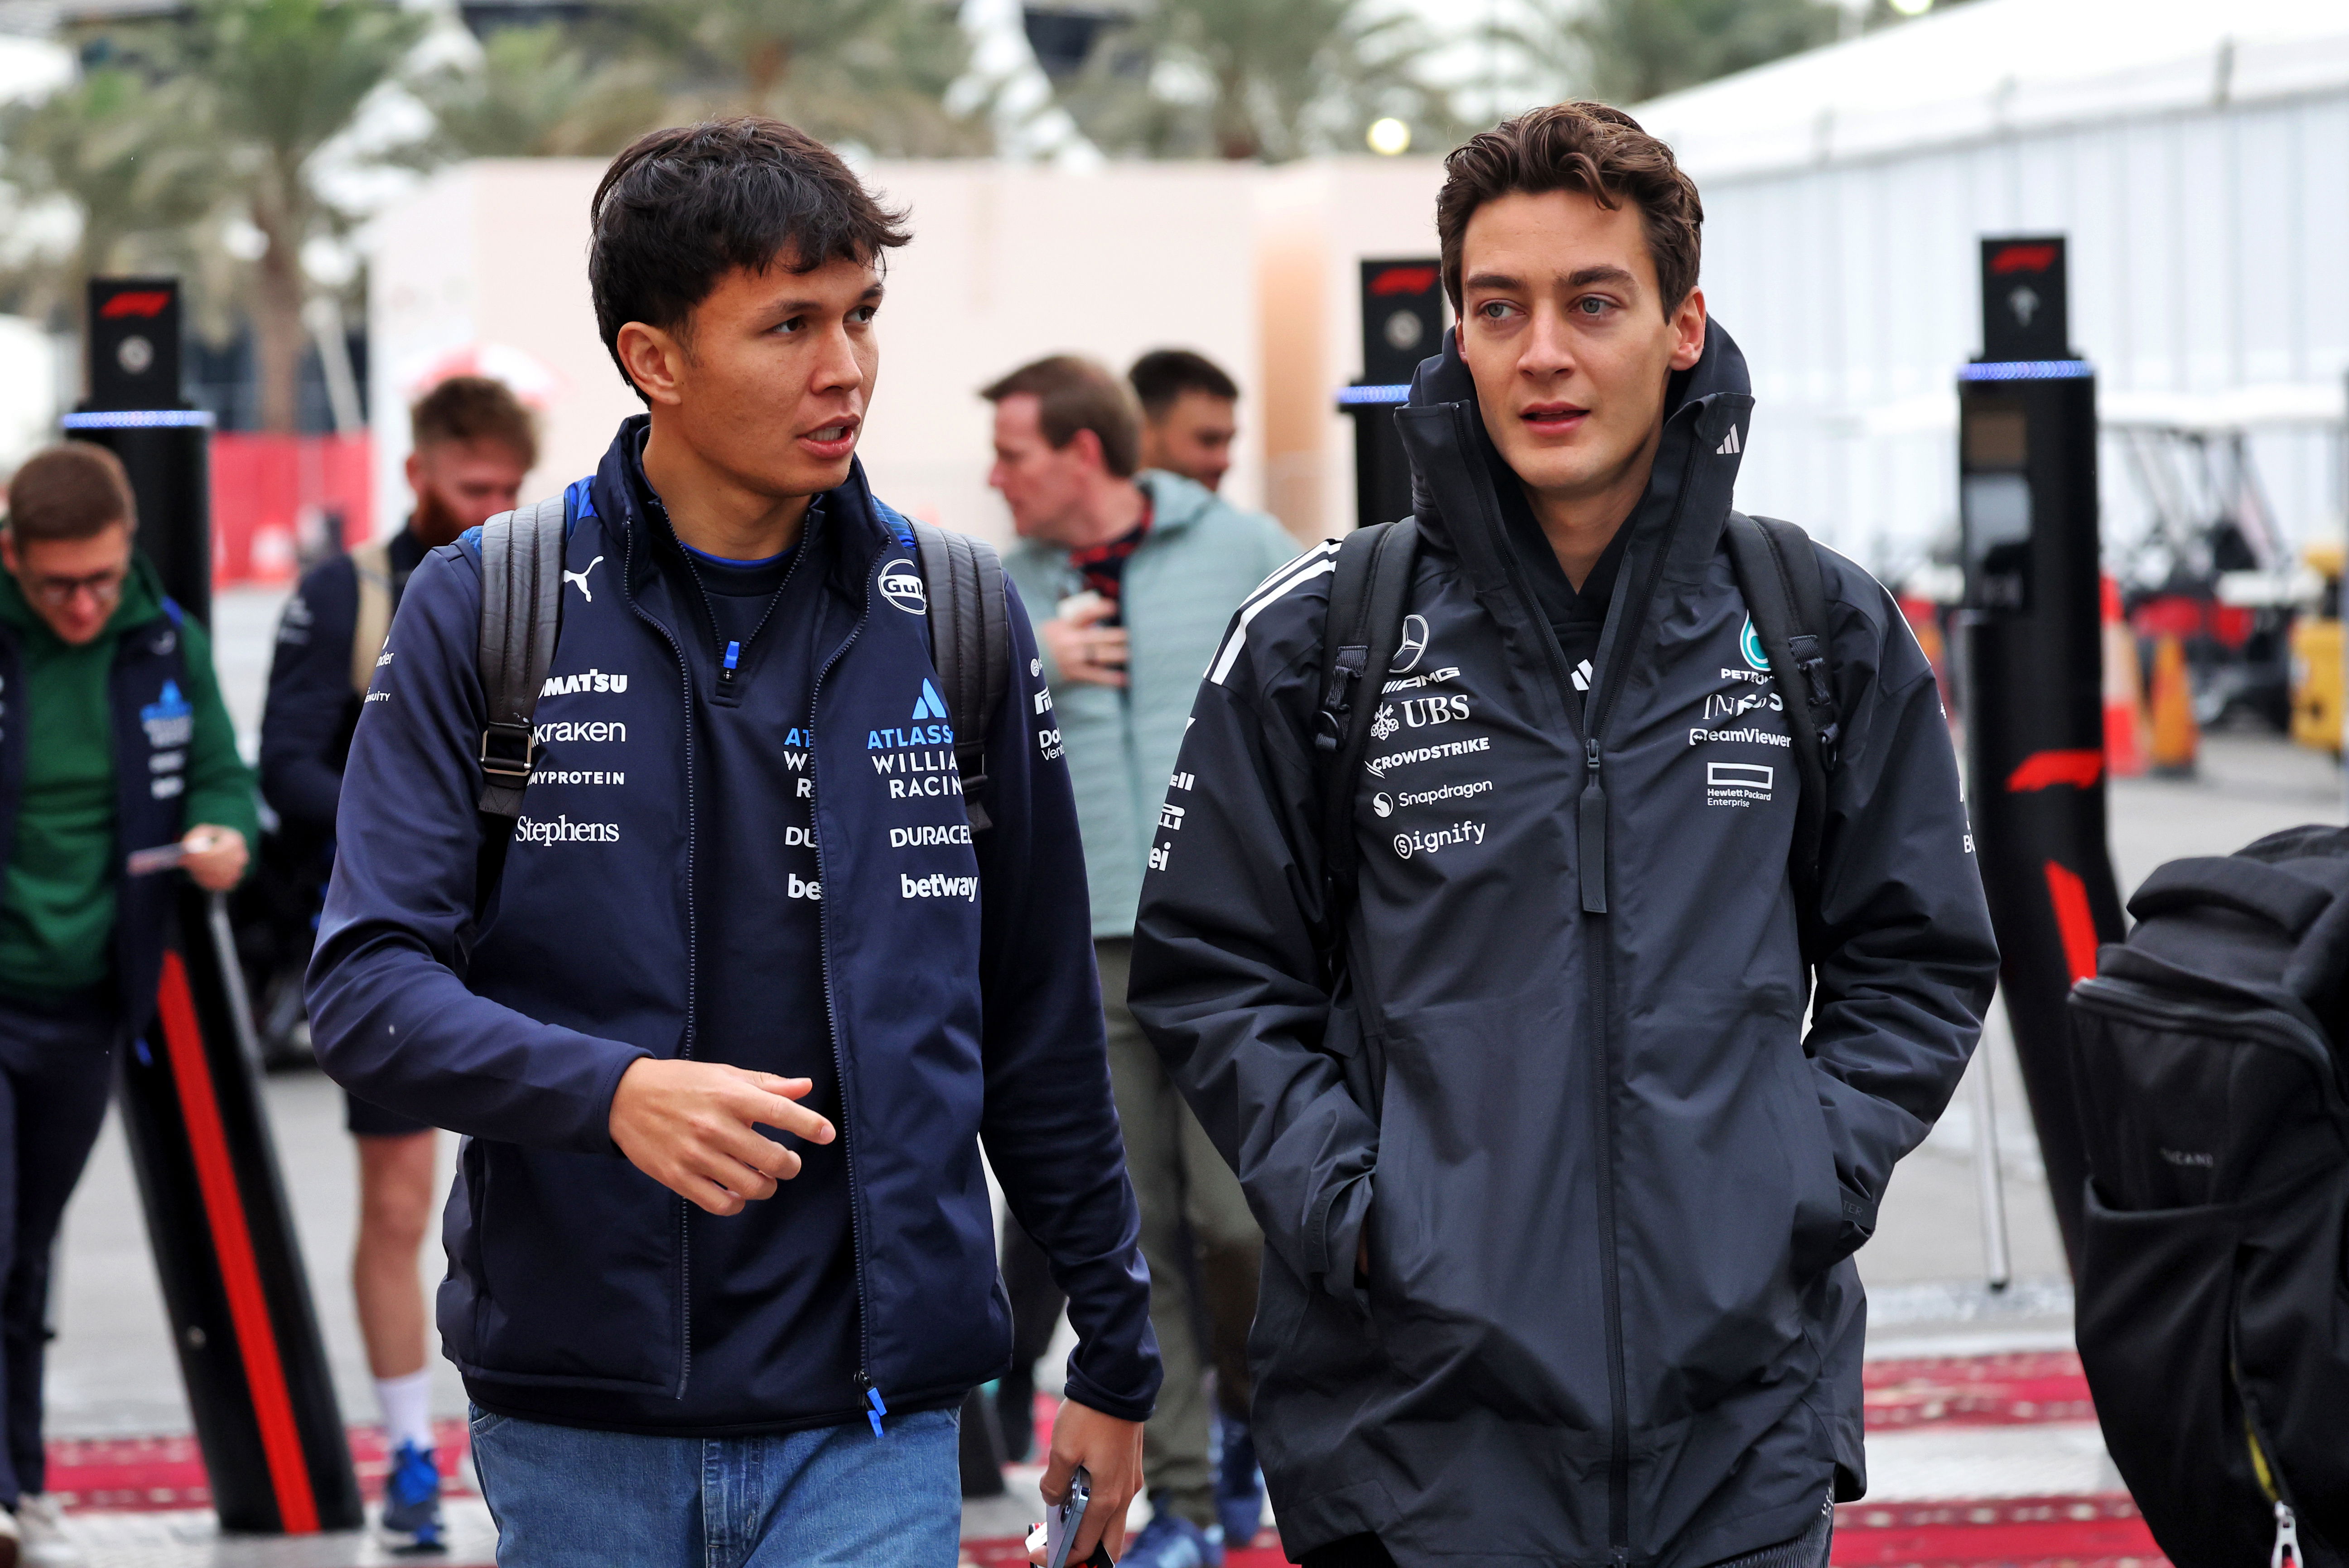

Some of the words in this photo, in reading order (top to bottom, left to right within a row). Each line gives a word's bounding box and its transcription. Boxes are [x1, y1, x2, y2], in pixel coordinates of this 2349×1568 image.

[883, 578, 922, 596] Gul
[538, 669, 628, 699] MATSU
[1401, 694, 1470, 728] UBS
[533, 721, 626, 746] kraken
[868, 724, 954, 750] ATLASS
[871, 750, 958, 775] WILLIA
[1373, 737, 1490, 770] CROWDSTRIKE
[530, 771, 625, 785] MYPROTEIN
[889, 776, 964, 799] RACIN
[1399, 780, 1493, 807] Snapdragon
[1707, 788, 1744, 797] Hewlett
[1744, 790, 1772, 801] Packard
[1707, 797, 1750, 808] Enterprise
[515, 814, 620, 847] Stephens
[890, 825, 973, 848] DURACEL
[900, 873, 979, 902] betway
